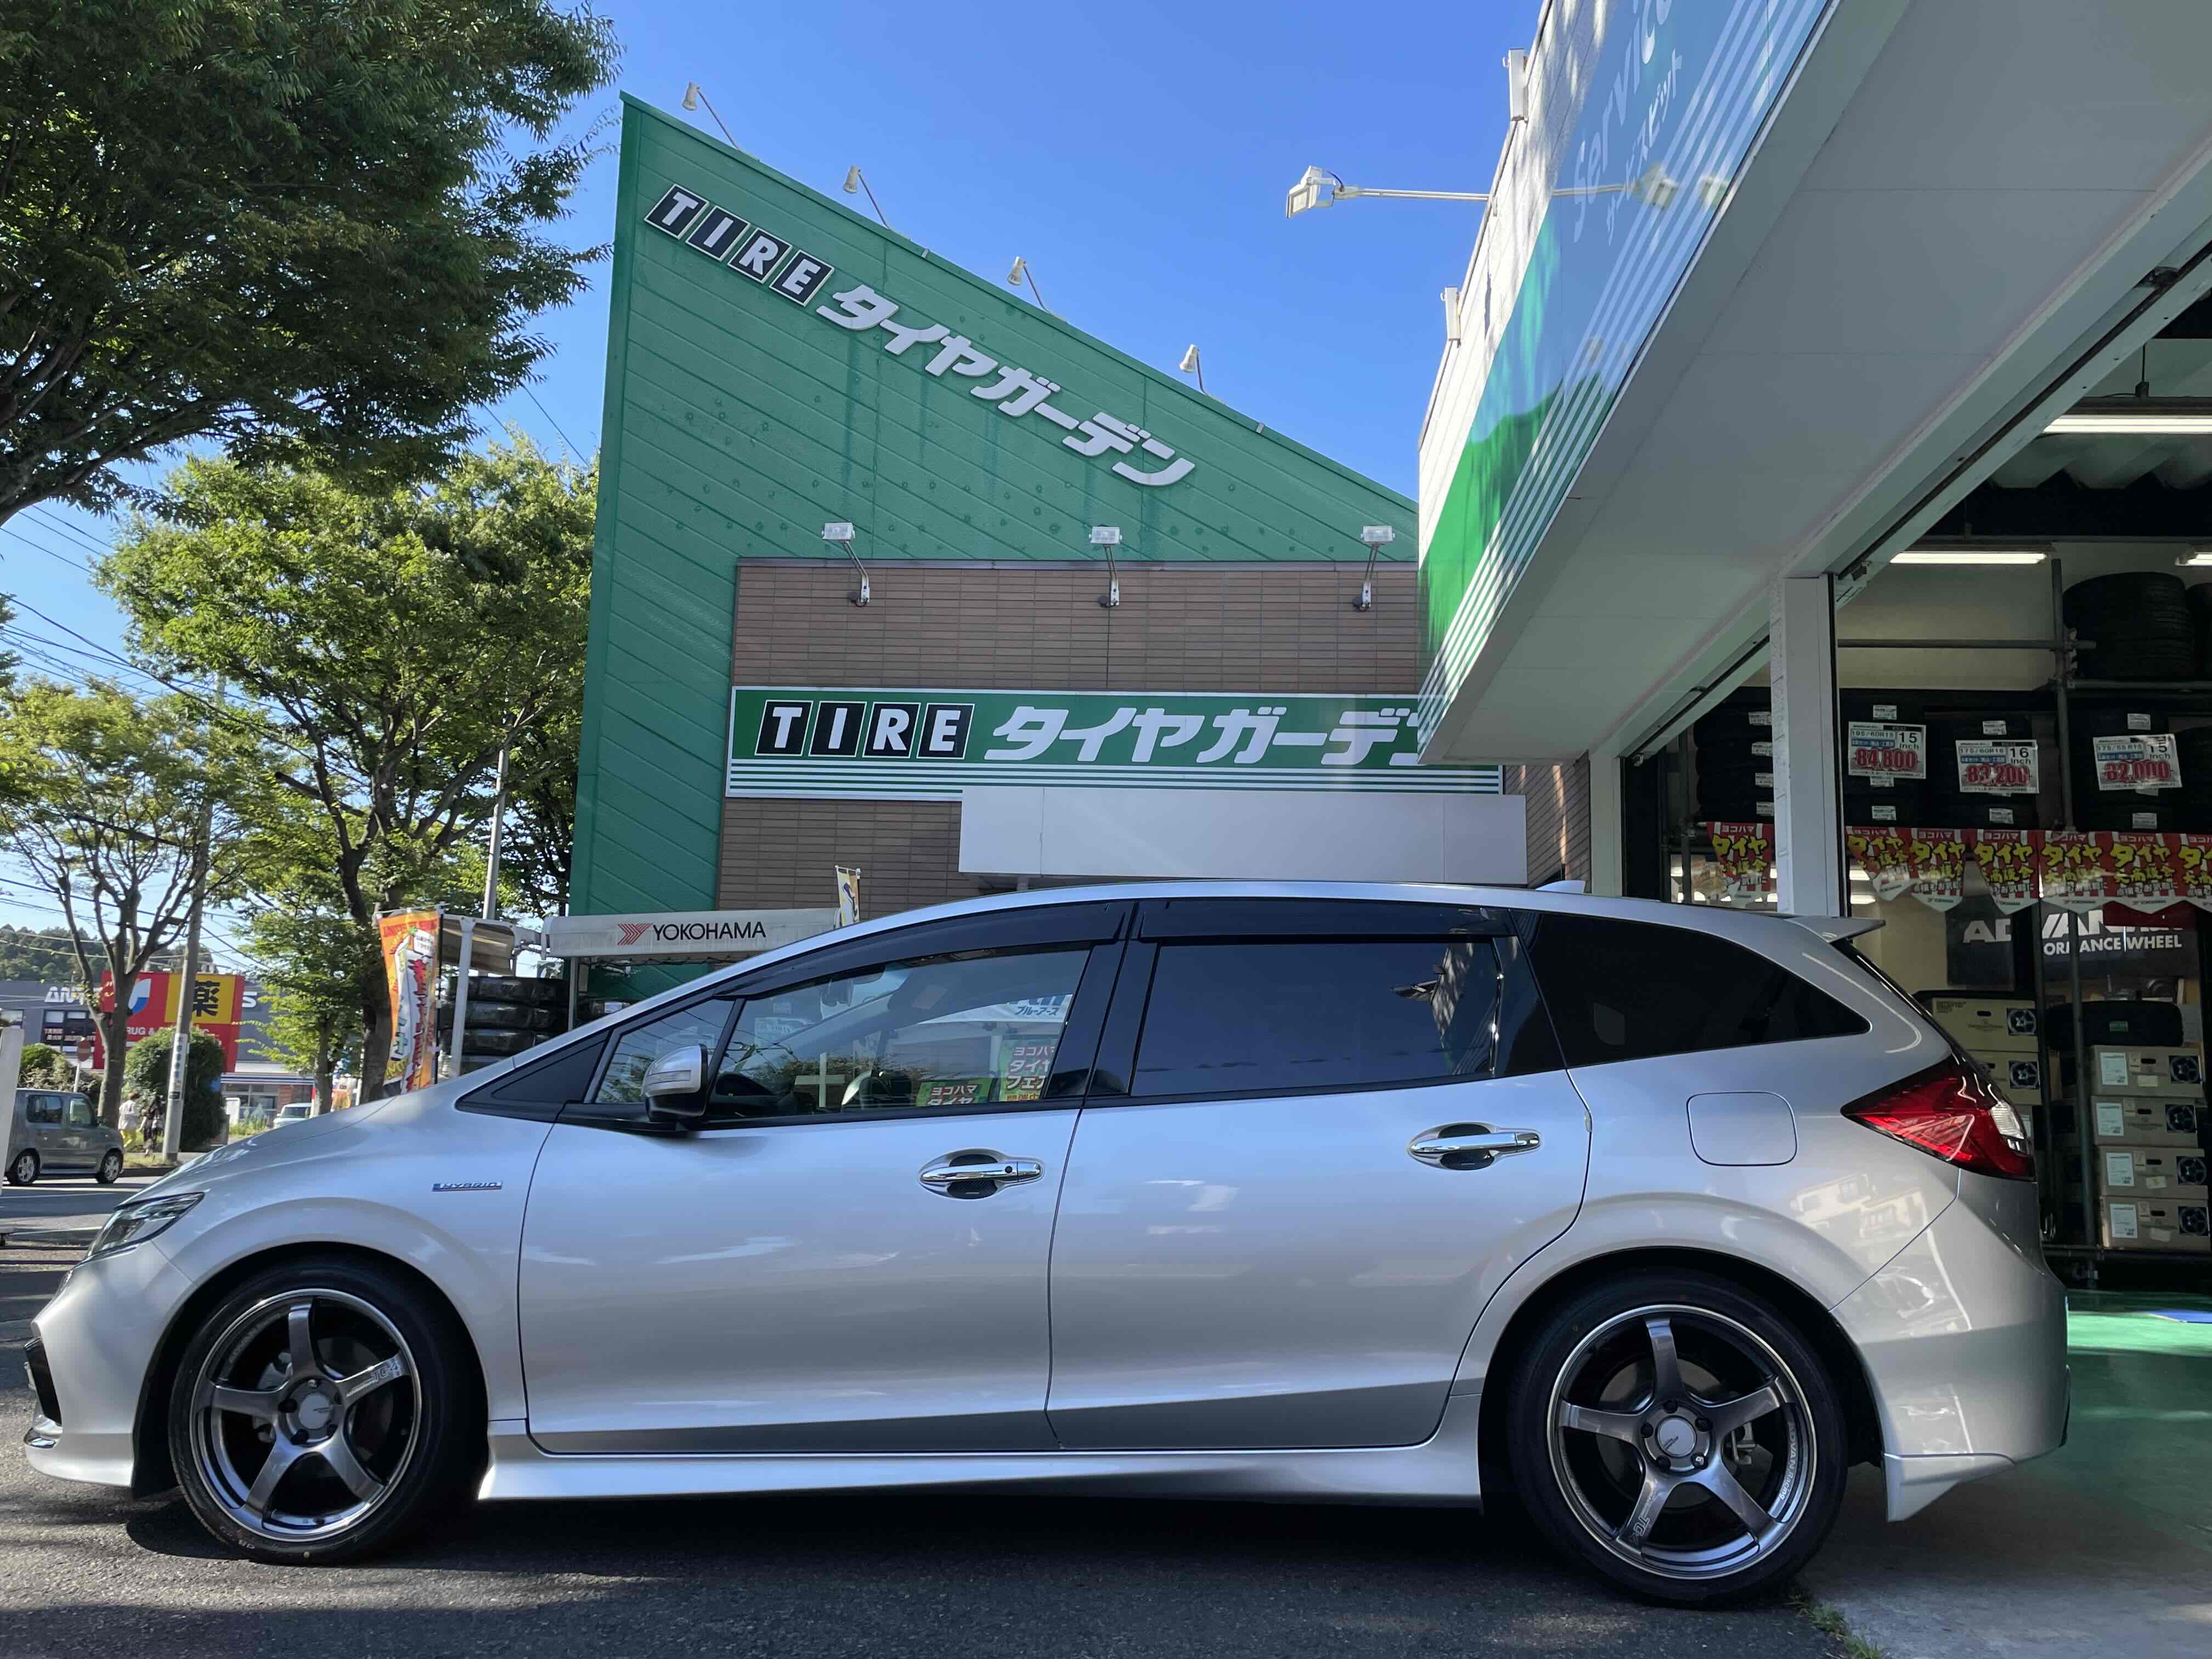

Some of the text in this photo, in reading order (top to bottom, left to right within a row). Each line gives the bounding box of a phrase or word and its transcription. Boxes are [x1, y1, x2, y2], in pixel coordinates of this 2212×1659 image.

[1606, 48, 1683, 246] サービスピット
[661, 191, 1196, 486] TIRE タイヤガーデン
[772, 706, 961, 751] TIRE
[1899, 732, 1917, 743] 15
[2010, 748, 2029, 758] 16
[1712, 833, 1768, 857] タイヤ
[1848, 835, 1904, 853] タイヤ
[1984, 832, 2020, 840] ヨコハマ
[2120, 834, 2155, 843] ヨコハマ
[1910, 840, 1966, 865] タイヤ
[1974, 841, 2033, 866] タイヤ
[2042, 842, 2102, 867] タイヤ
[2111, 843, 2171, 868] タイヤ
[653, 921, 766, 940] YOKOHAMA
[2044, 934, 2182, 956] ORANCE WHEEL
[192, 980, 221, 1017] 薬
[127, 1026, 145, 1035] RUG
[931, 1085, 979, 1096] ヨコハマ
